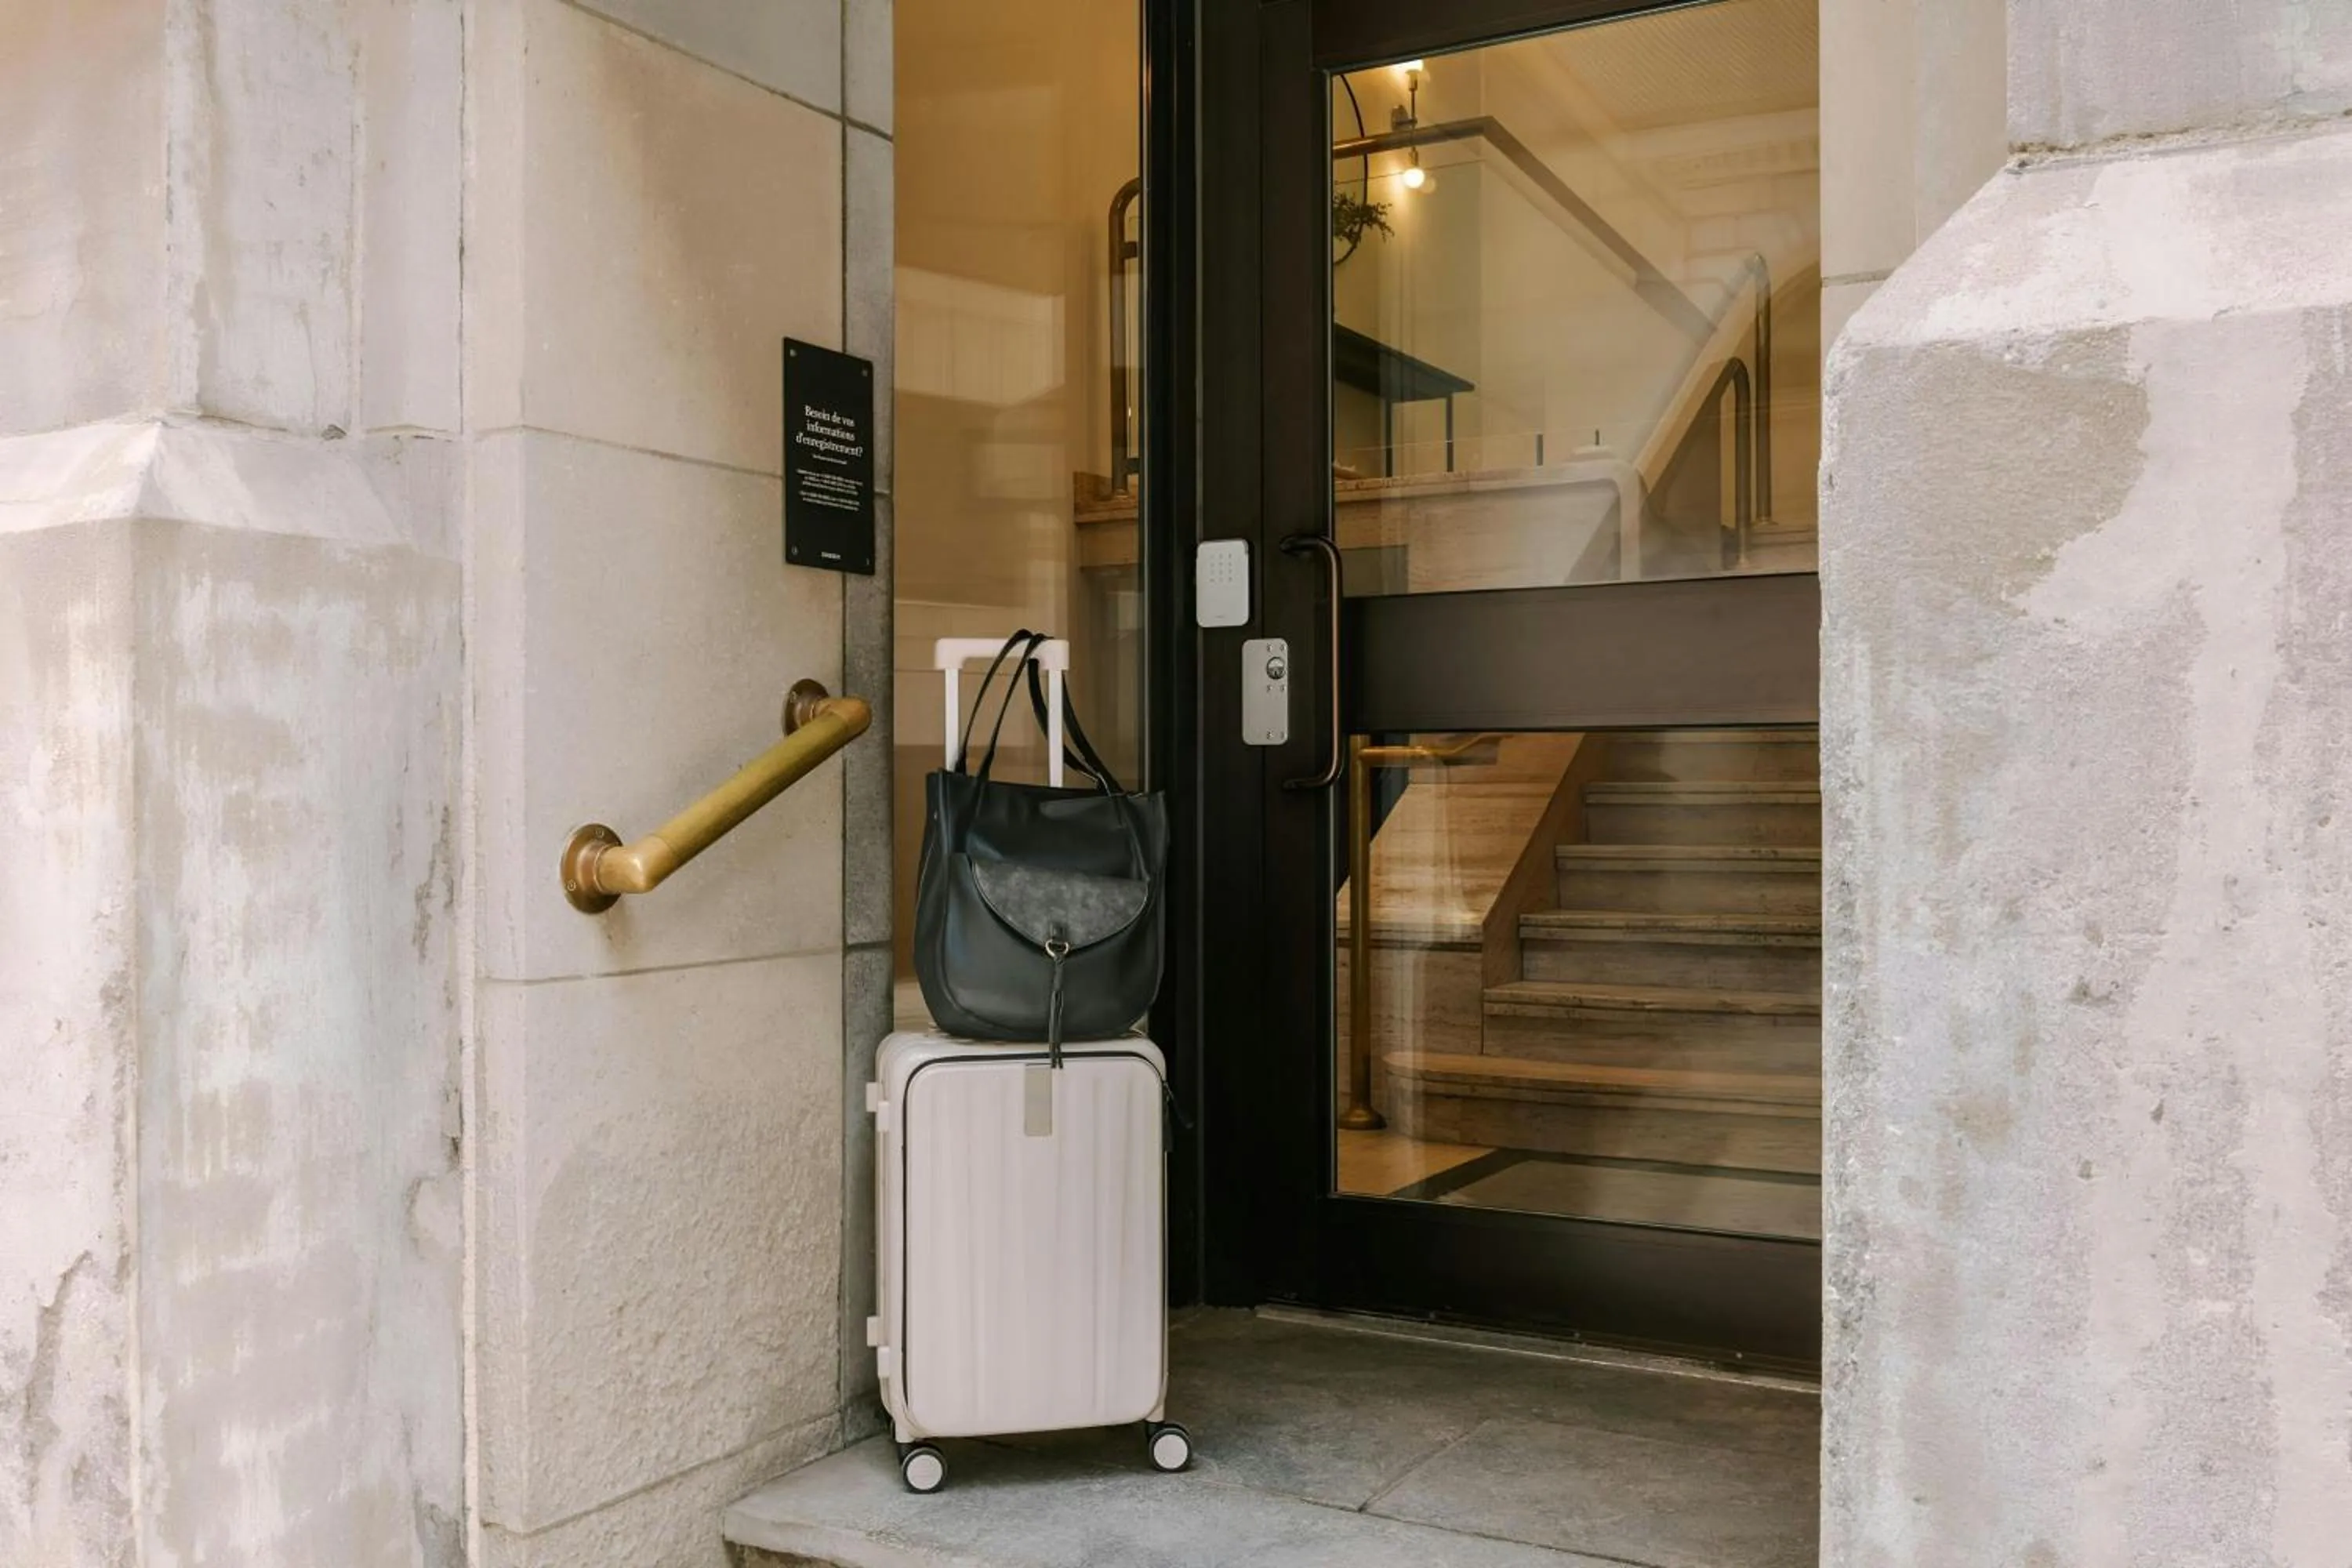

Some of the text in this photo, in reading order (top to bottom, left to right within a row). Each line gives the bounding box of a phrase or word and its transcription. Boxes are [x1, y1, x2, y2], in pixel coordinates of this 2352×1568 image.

[805, 405, 855, 427] Besoin de vos
[807, 419, 855, 441] informations
